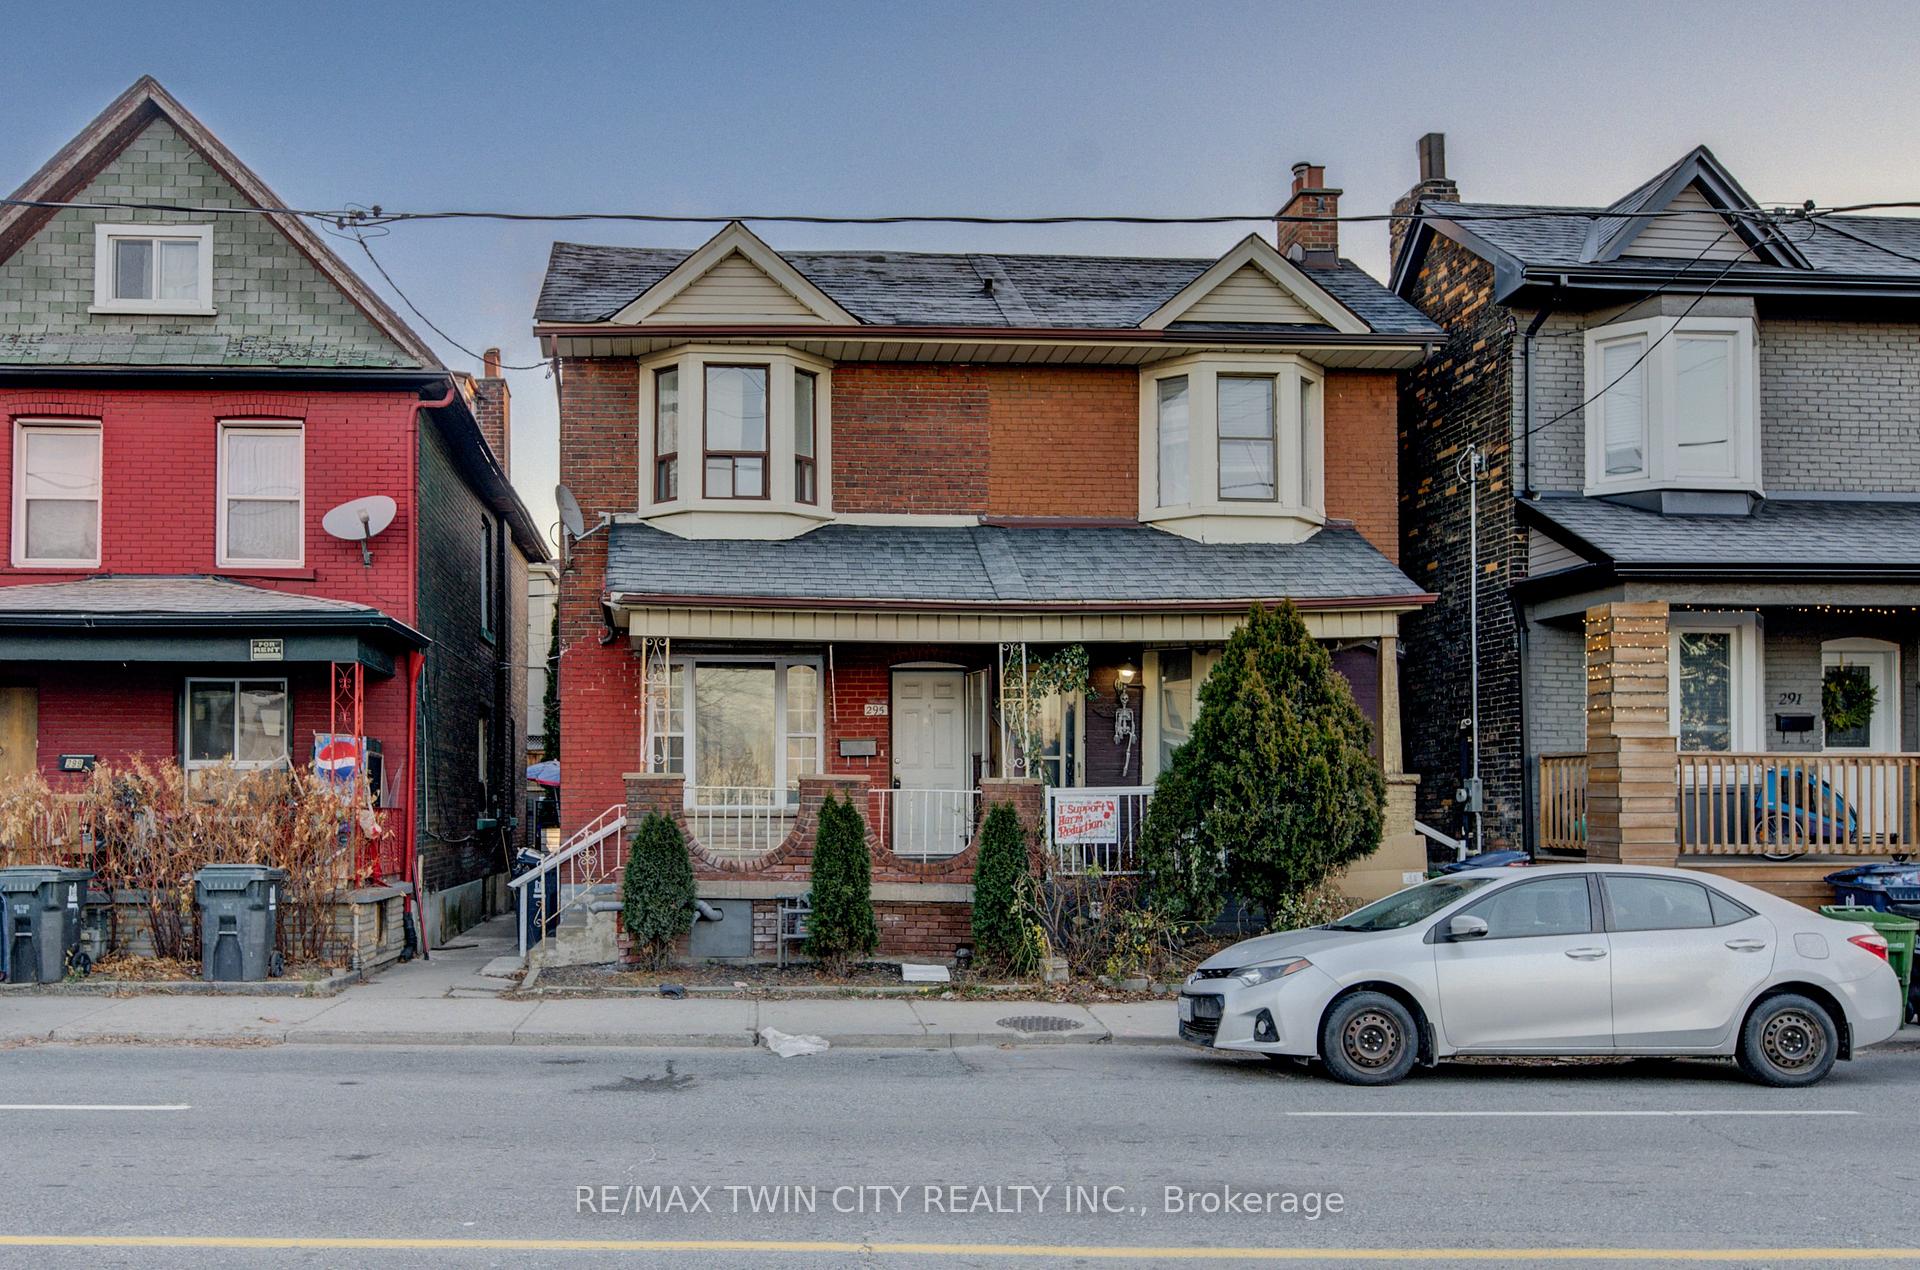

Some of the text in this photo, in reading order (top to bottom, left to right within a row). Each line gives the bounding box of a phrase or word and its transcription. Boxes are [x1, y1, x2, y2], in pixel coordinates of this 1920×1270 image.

[1779, 692, 1802, 705] 291
[866, 705, 885, 715] 295
[1067, 803, 1105, 814] Support
[1058, 815, 1084, 826] Harm
